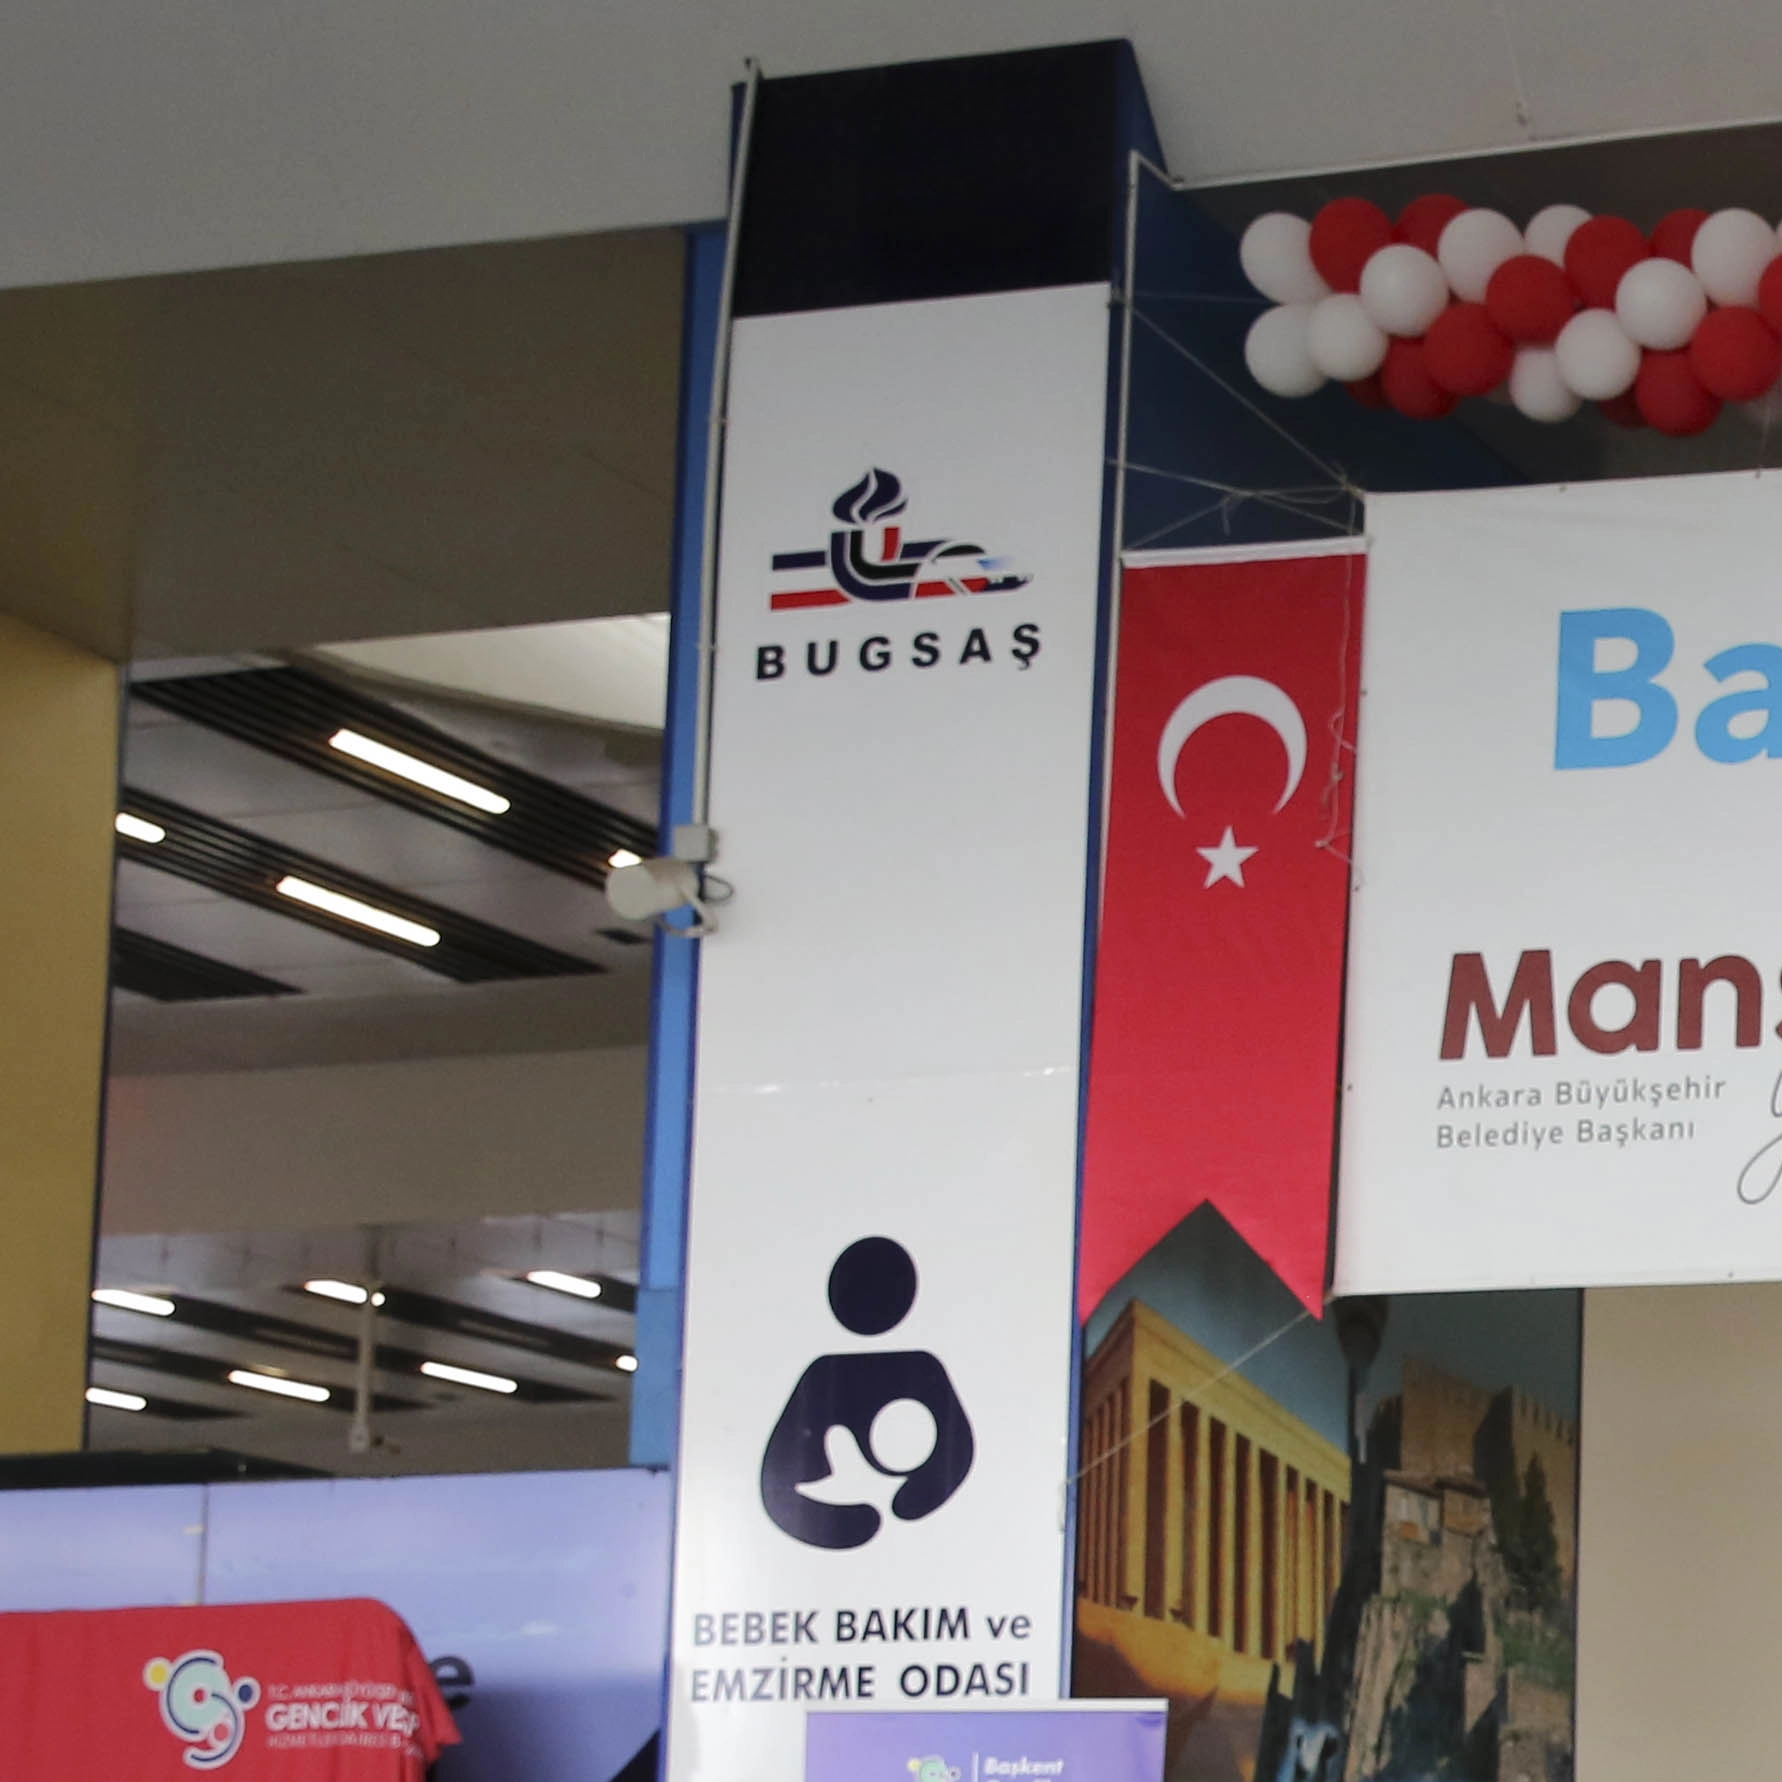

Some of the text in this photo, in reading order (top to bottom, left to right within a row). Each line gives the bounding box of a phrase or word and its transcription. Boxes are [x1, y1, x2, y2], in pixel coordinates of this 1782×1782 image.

[755, 623, 1041, 681] BUGSAŞ
[1436, 1074, 1727, 1111] Ankara Büyükşehir
[1436, 1117, 1695, 1152] Belediye Başkanı
[693, 1607, 1032, 1646] BEBEK BAKIM ve
[692, 1657, 1029, 1701] EMZİRME ODASI
